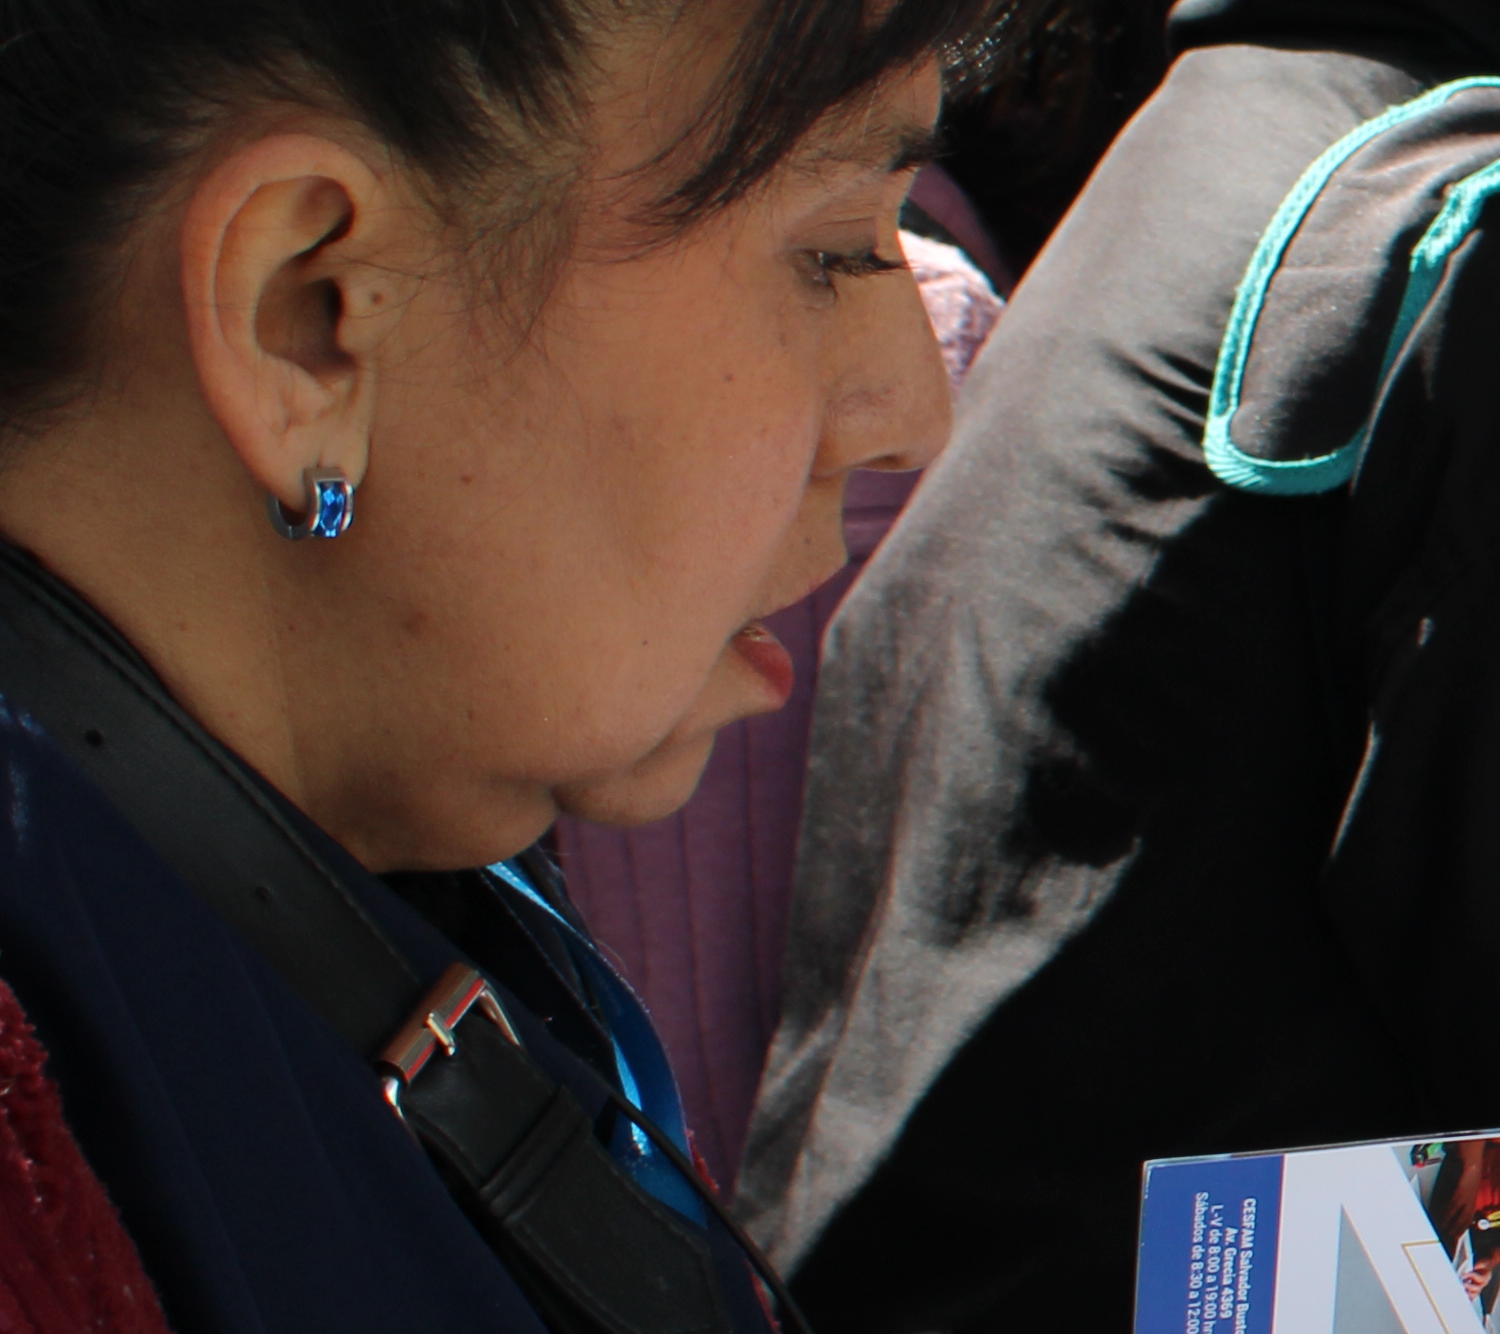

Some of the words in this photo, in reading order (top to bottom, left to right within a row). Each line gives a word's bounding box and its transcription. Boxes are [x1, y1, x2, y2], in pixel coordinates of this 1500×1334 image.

[1193, 1192, 1208, 1243] Sábados
[1210, 1205, 1224, 1225] L-V
[1240, 1199, 1256, 1248] CESFAM
[1209, 1229, 1220, 1243] de
[1224, 1227, 1238, 1244] Av.
[1192, 1246, 1205, 1260] de
[1207, 1246, 1219, 1271] 8:00
[1222, 1248, 1236, 1285] Grecia
[1190, 1262, 1203, 1288] 8:30
[1238, 1250, 1252, 1301] Salvador
[1204, 1287, 1217, 1317] 19:00
[1220, 1288, 1233, 1318] 4369
[1187, 1303, 1200, 1334] 12:00
